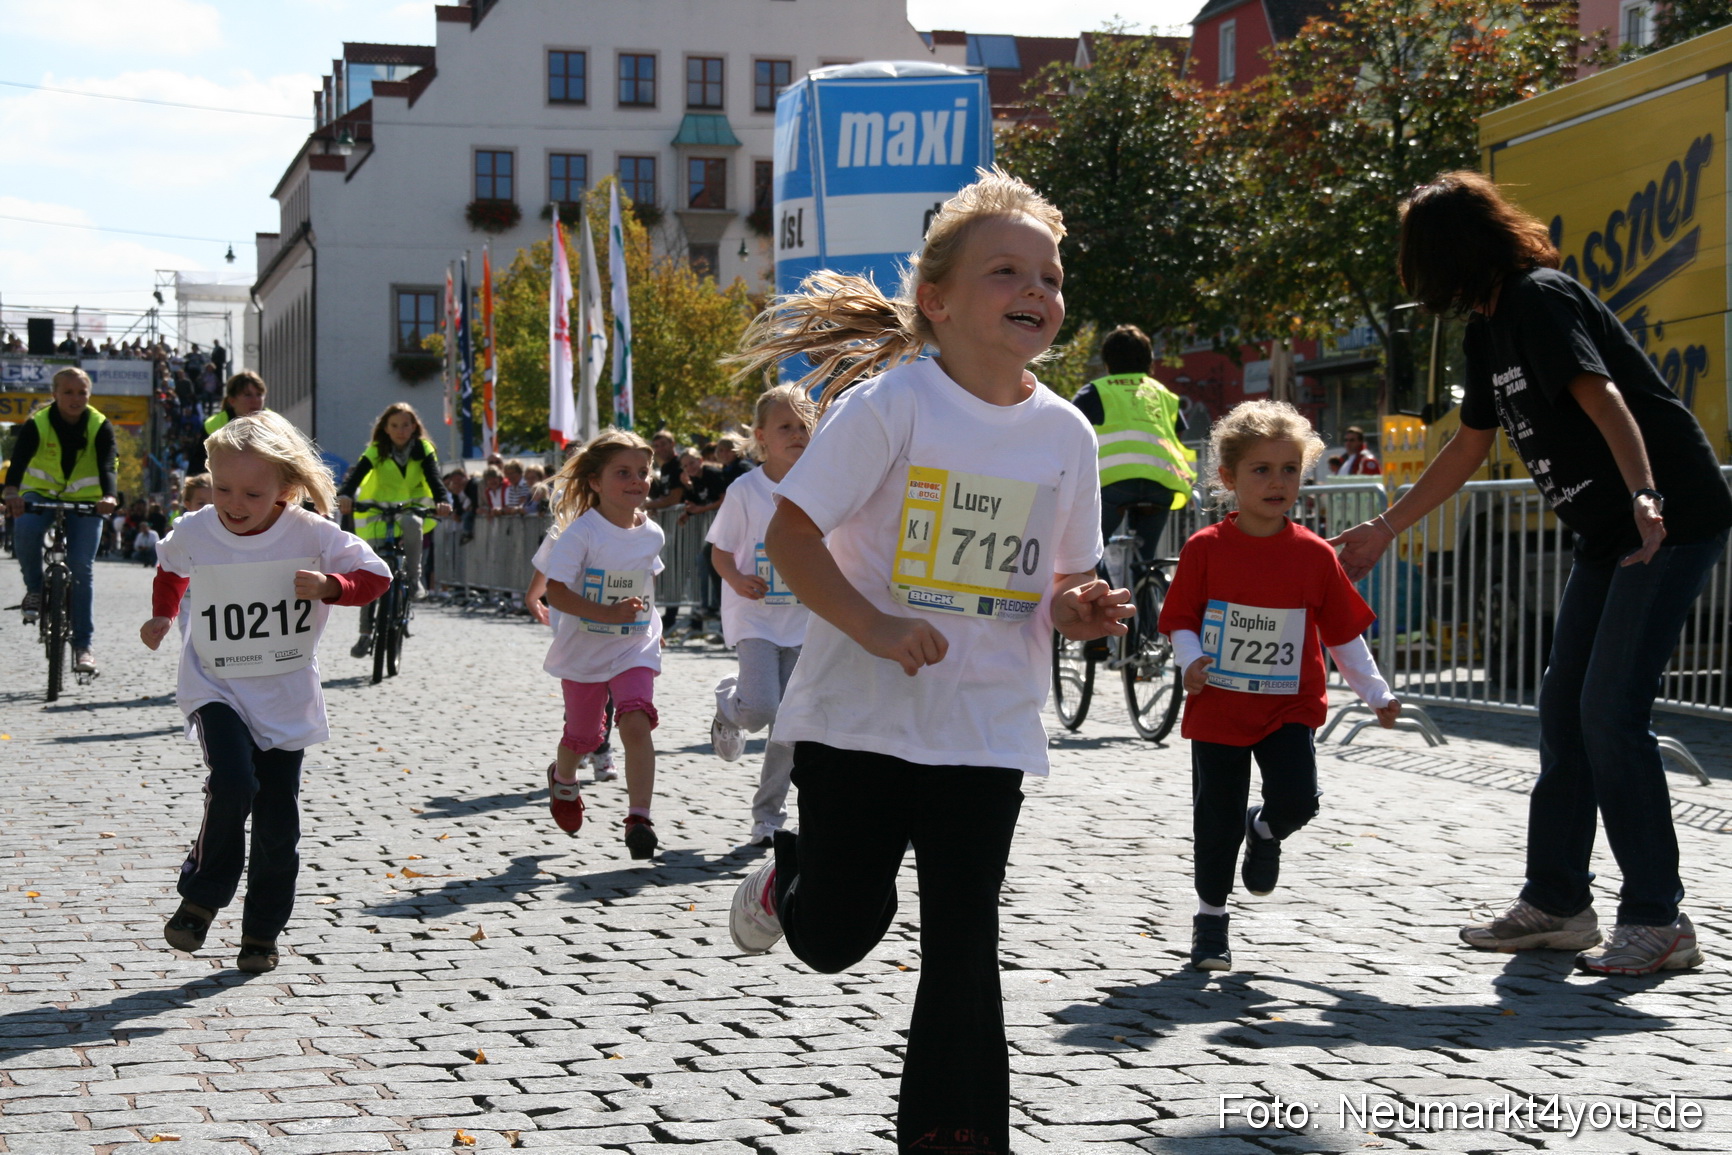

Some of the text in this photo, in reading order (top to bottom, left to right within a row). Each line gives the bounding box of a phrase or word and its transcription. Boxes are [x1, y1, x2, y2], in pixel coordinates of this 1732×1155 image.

[837, 98, 968, 168] maxi
[780, 208, 804, 250] dsl
[0, 365, 44, 382] CK
[99, 370, 149, 380] PFLEIDERER
[952, 482, 1002, 520] Lucy
[907, 519, 930, 541] K 1
[951, 527, 1040, 576] 7120
[758, 566, 764, 576] K
[607, 575, 633, 589] Luisa
[607, 595, 650, 613] 75
[908, 590, 954, 605] BOCK
[201, 598, 312, 641] 10212
[1230, 610, 1277, 632] Sophia
[1204, 631, 1212, 644] K
[225, 655, 263, 663] PFLEIDERER
[275, 649, 299, 659] BOCK
[1229, 637, 1295, 666] 7223
[1260, 680, 1298, 689] PFLEIDERER
